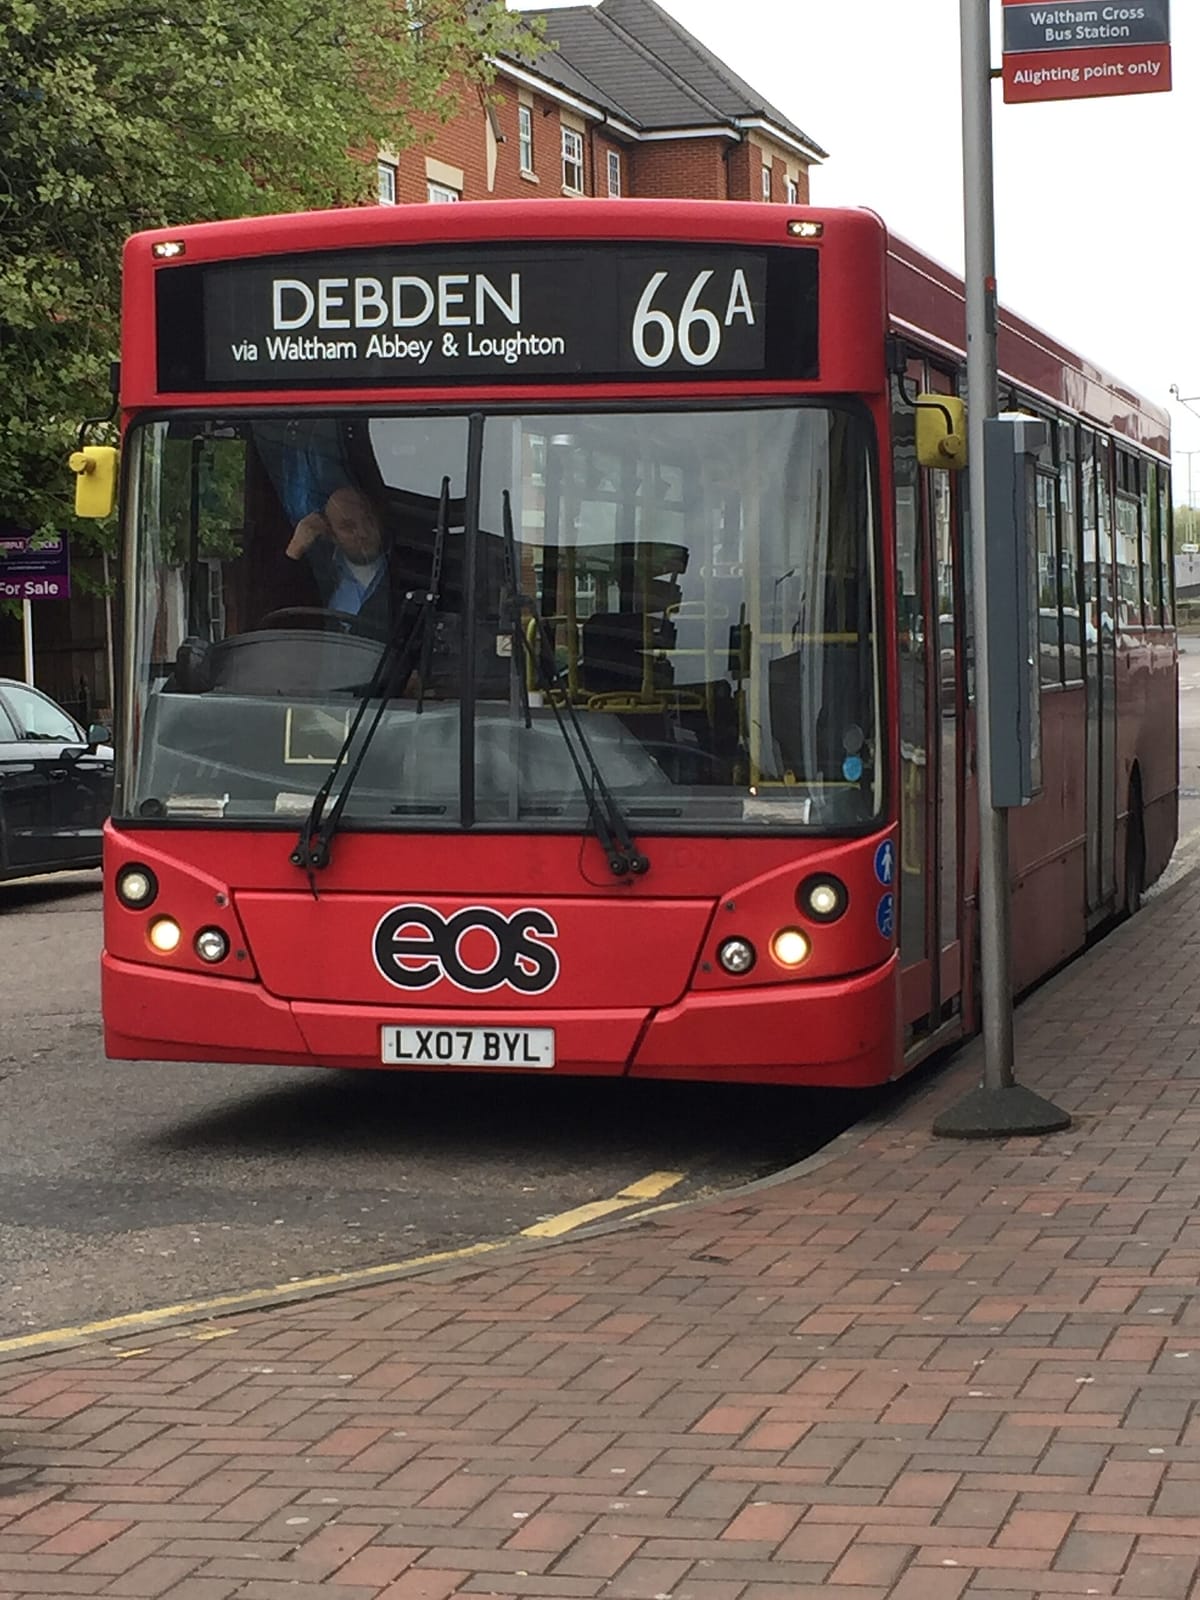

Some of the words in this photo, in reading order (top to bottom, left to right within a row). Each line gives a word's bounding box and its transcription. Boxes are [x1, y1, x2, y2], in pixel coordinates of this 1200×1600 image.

[1030, 9, 1098, 25] Waltham
[1102, 7, 1145, 21] Cross
[1045, 28, 1072, 41] Bus
[1075, 24, 1130, 40] Station
[1013, 66, 1080, 86] Alighting
[1084, 63, 1124, 80] point
[1128, 60, 1161, 77] only
[272, 273, 520, 330] DEBDEN
[232, 340, 258, 361] via
[266, 335, 357, 361] Waltham
[366, 334, 433, 364] Abbey
[442, 332, 459, 357] &
[467, 331, 565, 364] Loughton
[24, 581, 59, 595] Sale
[372, 902, 560, 996] eos
[395, 1030, 473, 1060] LX07
[483, 1032, 541, 1062] BYL
